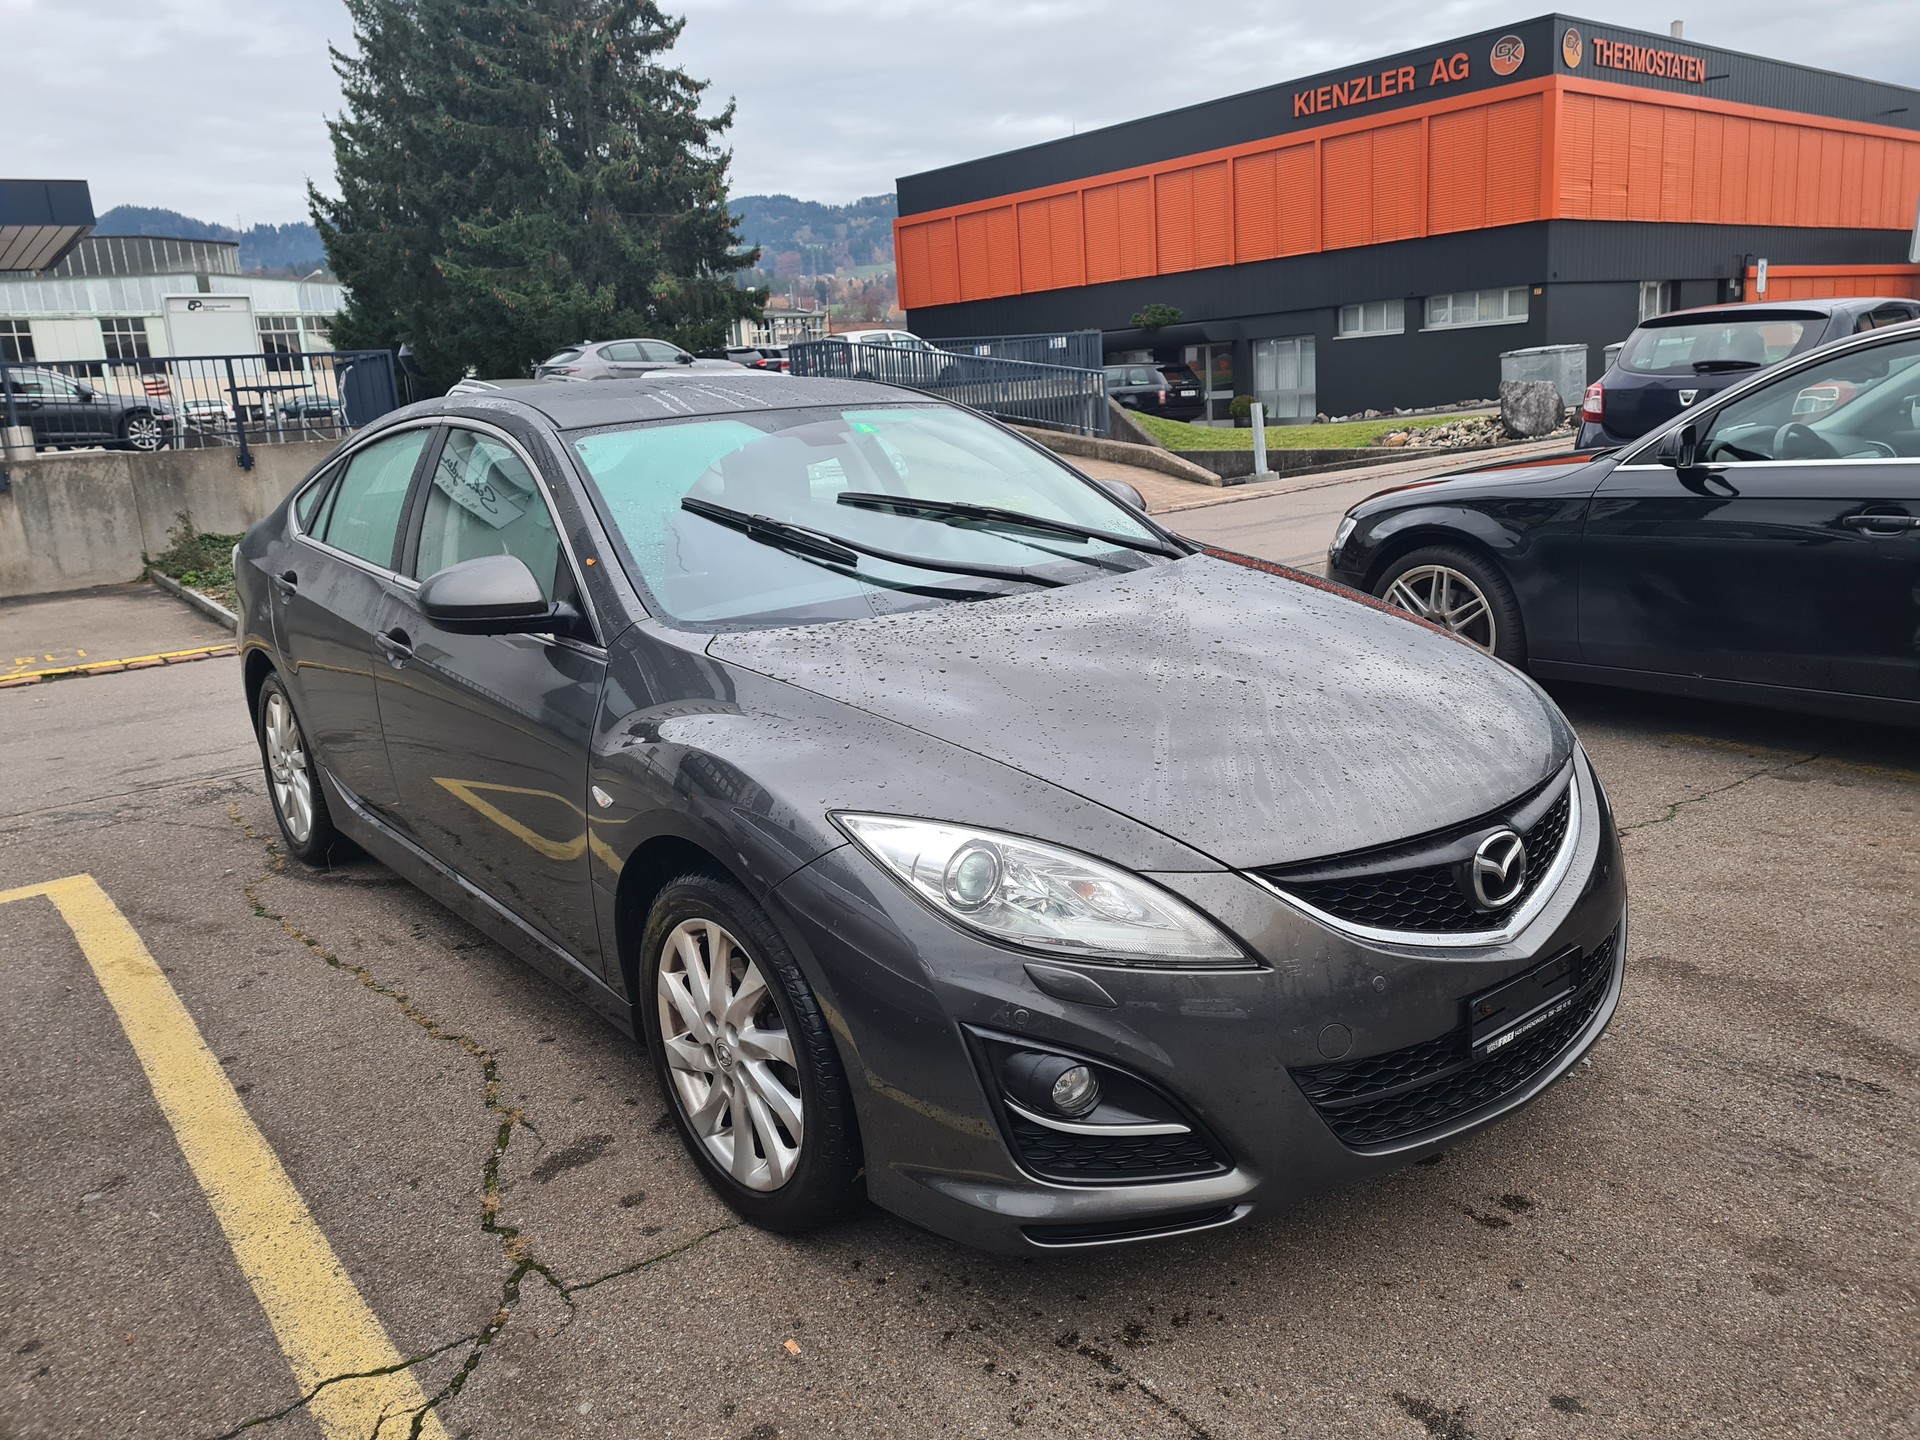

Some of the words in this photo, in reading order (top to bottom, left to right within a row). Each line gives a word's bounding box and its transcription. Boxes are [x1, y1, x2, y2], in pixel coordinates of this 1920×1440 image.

[1592, 38, 1706, 83] THERMOSTATEN
[1293, 65, 1416, 118] KIENZLER
[1429, 51, 1470, 87] AG
[1498, 1031, 1515, 1047] FREI
